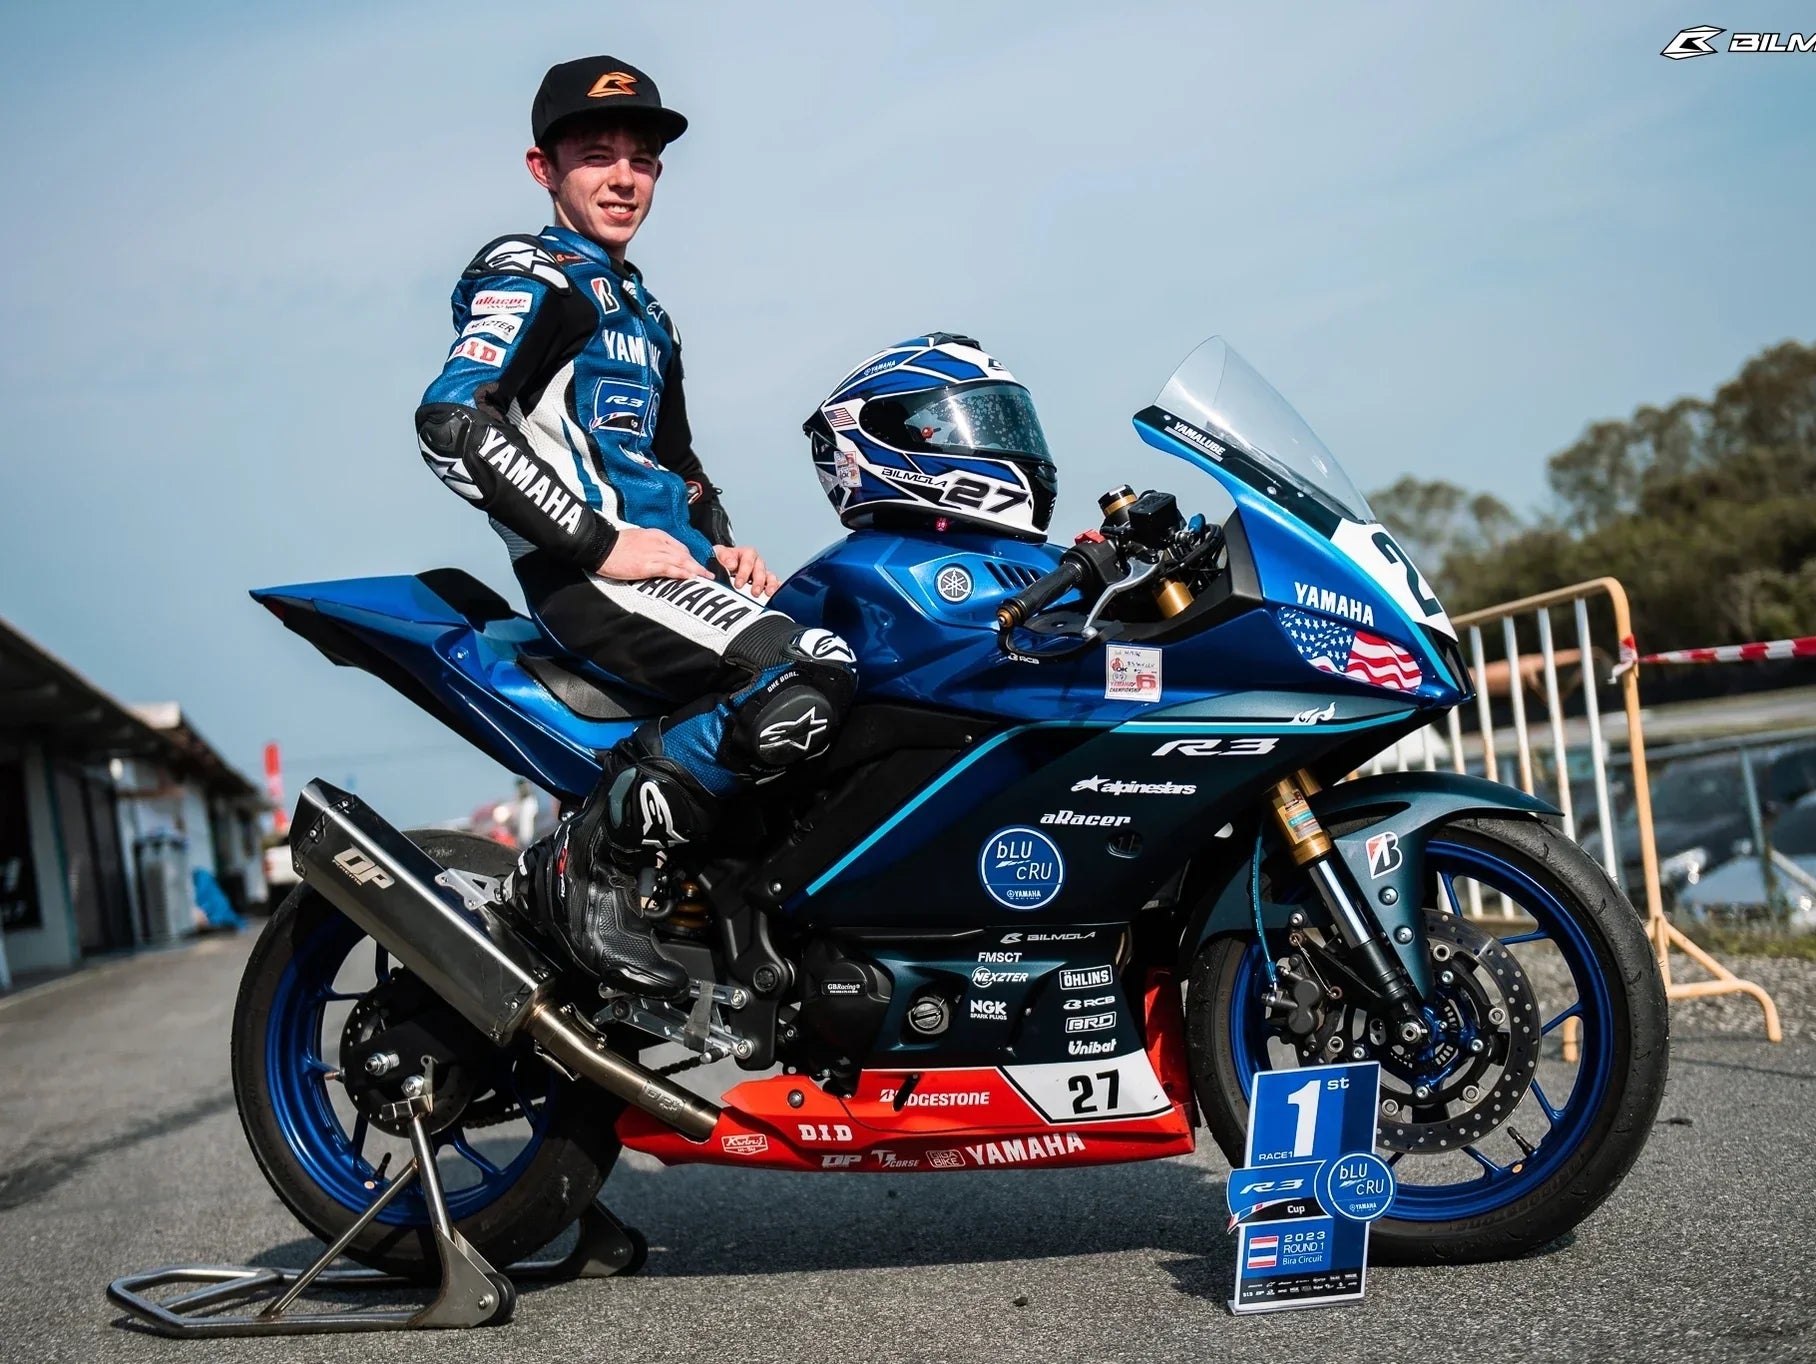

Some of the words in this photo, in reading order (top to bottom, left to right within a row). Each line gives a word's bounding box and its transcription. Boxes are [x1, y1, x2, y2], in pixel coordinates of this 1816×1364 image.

[871, 360, 896, 374] YAMAHA
[605, 395, 645, 408] R3
[1174, 421, 1226, 456] YAMALUBE
[477, 426, 584, 536] YAMAHA
[881, 468, 948, 488] BILMOLA
[944, 477, 1029, 513] 27
[634, 578, 753, 633] AMAHA
[1294, 581, 1375, 627] YAMAHA
[1152, 737, 1280, 757] R3
[1100, 780, 1197, 796] alpinestars
[1040, 810, 1131, 827] aRacer
[996, 841, 1033, 859] bLU
[1016, 862, 1052, 880] cRU
[1026, 931, 1096, 941] BILMOLA
[978, 952, 1022, 963] FMSCT
[972, 972, 1029, 982] NEXZTER
[1063, 970, 1109, 987] ÖHLINS
[970, 1000, 1007, 1015] NGK
[1083, 995, 1116, 1008] RCB
[1068, 1014, 1113, 1031] BRD
[1068, 1038, 1117, 1055] Unibat
[879, 1088, 990, 1107] BDGESTONE
[1067, 1069, 1120, 1115] 27
[797, 1124, 853, 1142] D.I.D
[965, 1132, 1087, 1166] YAMAHA
[889, 1160, 920, 1168] CORSE
[1340, 1163, 1368, 1180] bLU
[1240, 1178, 1304, 1195] R3
[1356, 1179, 1385, 1195] cRU
[1287, 1205, 1306, 1215] Cup
[1355, 1202, 1377, 1210] YAMAHA
[1284, 1231, 1326, 1243] 2023
[1283, 1241, 1318, 1254] ROUND
[1320, 1241, 1324, 1250] 1
[1282, 1257, 1297, 1266] Bira
[1298, 1254, 1323, 1264] Circuit
